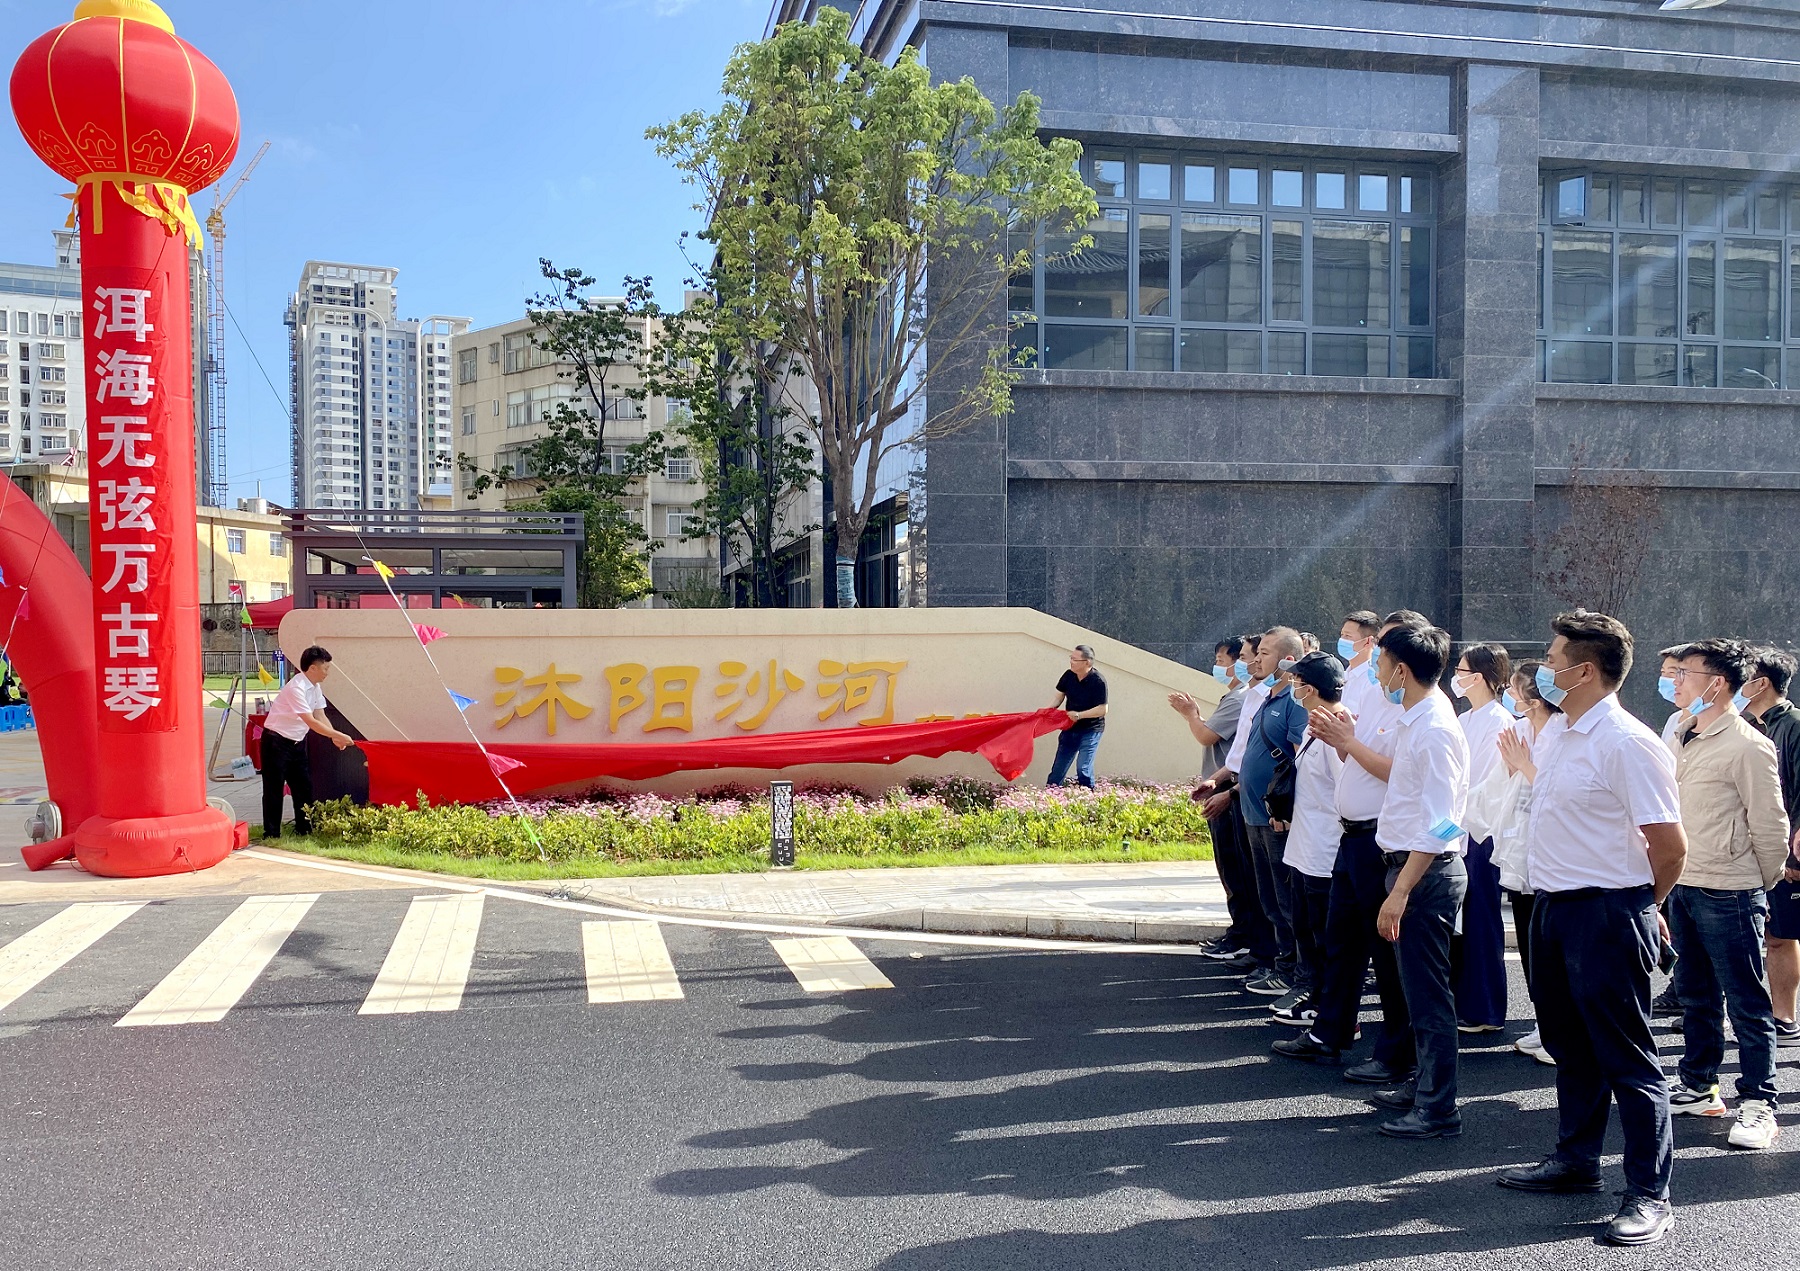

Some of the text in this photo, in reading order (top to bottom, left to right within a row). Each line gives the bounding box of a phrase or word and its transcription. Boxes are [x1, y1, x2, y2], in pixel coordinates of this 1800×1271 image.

[93, 286, 161, 721] 洱海无弦万古琴
[494, 659, 907, 737] 沐阳沙河
